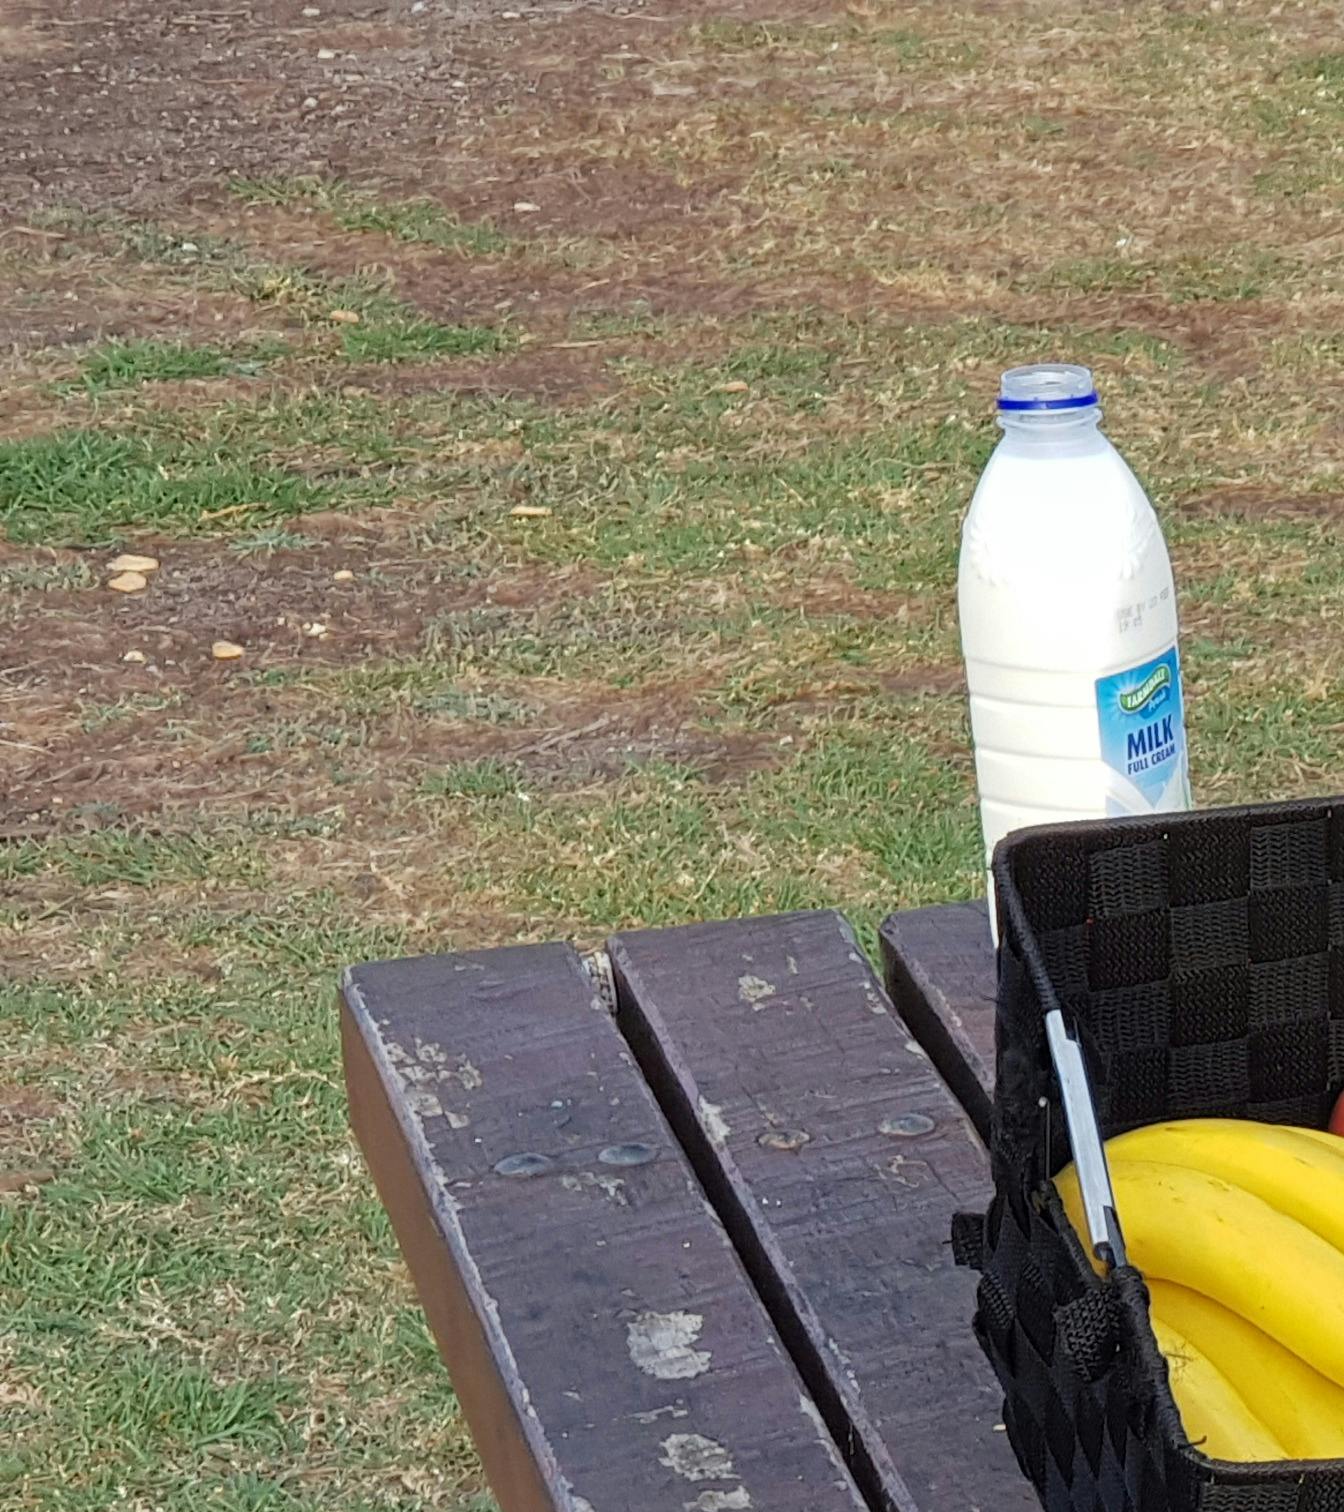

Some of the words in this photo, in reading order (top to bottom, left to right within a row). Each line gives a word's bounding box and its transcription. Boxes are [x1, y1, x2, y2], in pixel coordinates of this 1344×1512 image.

[1127, 714, 1174, 761] MILK
[1127, 758, 1149, 776] FULL
[1151, 743, 1176, 766] CREAM
